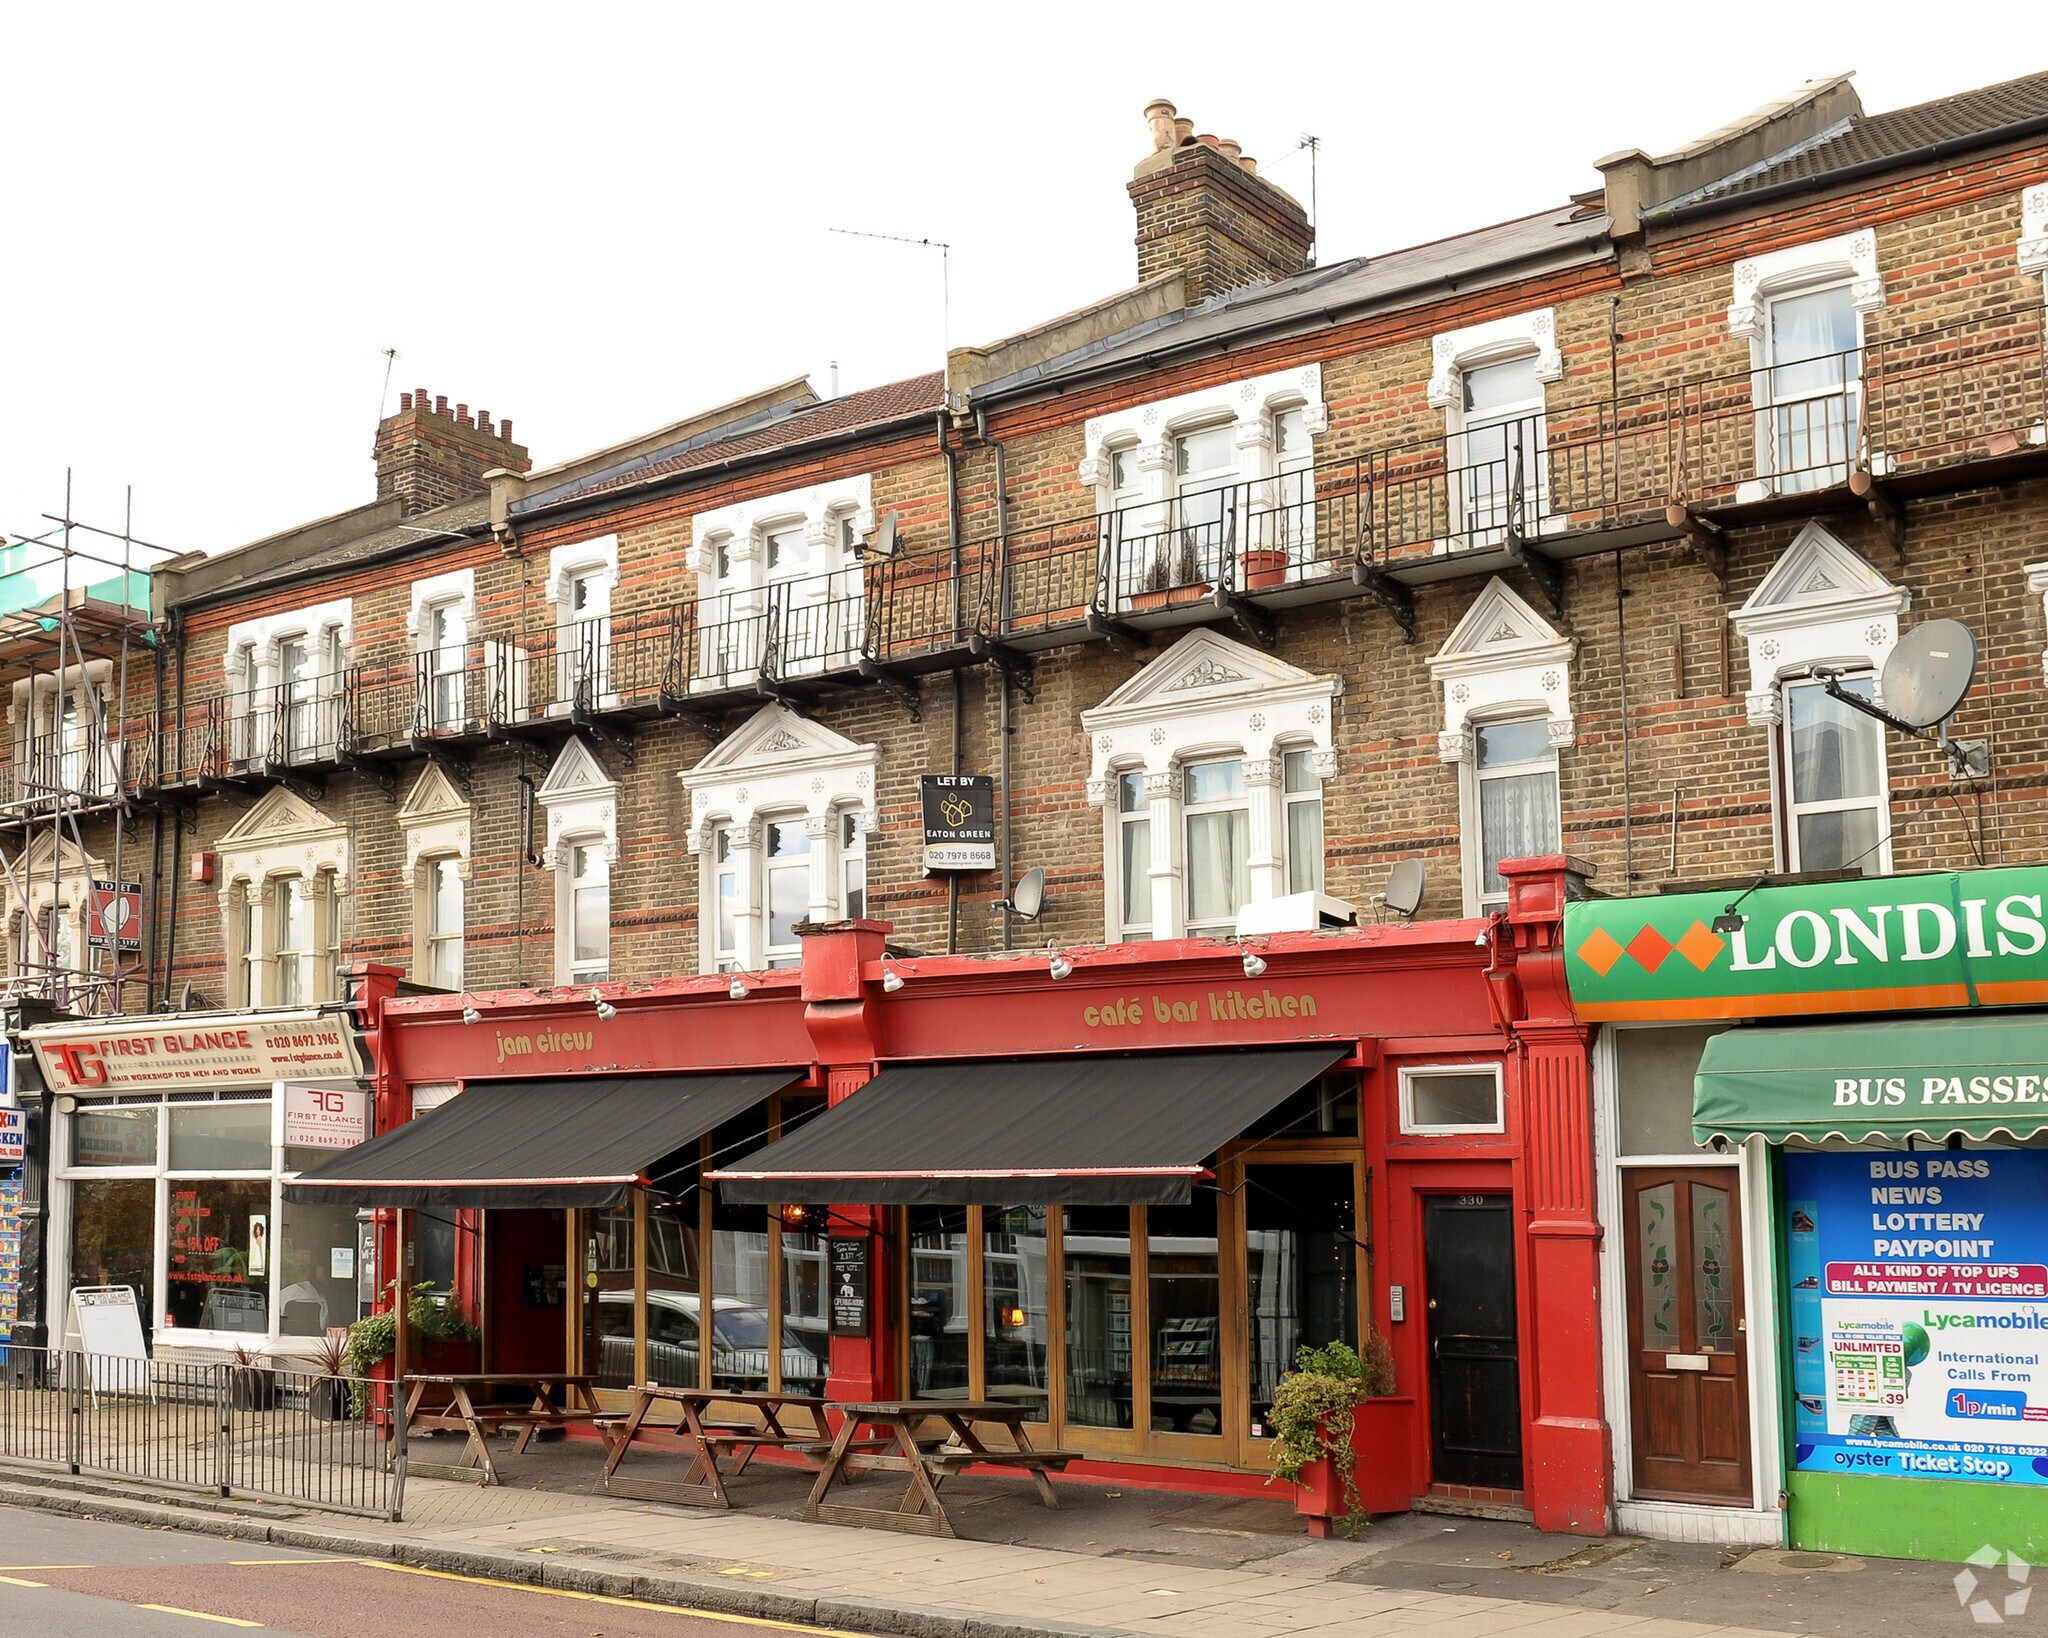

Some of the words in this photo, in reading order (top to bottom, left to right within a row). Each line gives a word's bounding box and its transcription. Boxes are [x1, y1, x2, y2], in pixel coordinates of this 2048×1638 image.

[937, 777, 957, 786] LET
[960, 777, 975, 786] BY
[926, 829, 956, 838] EATON
[959, 830, 991, 838] GREEN
[928, 851, 944, 860] 020
[946, 851, 968, 860] 7978
[969, 851, 991, 860] 8668
[100, 882, 114, 891] TO
[1729, 894, 2048, 971] LONDIS
[1083, 996, 1144, 1027] café
[1152, 995, 1199, 1024] bar
[1208, 989, 1317, 1021] kitchen
[98, 1037, 155, 1057] FIRST
[162, 1030, 252, 1053] GLANCE
[274, 1036, 291, 1049] 020
[292, 1034, 316, 1048] 8692
[316, 1032, 340, 1047] 3965
[495, 1030, 533, 1064] jam
[536, 1026, 594, 1053] circus
[270, 1050, 343, 1064] www.1stglance.co.uk
[111, 1074, 130, 1082] HAIR
[131, 1072, 174, 1081] WORKSHOP
[175, 1070, 191, 1079] FOR
[192, 1069, 210, 1078] MEN
[212, 1068, 229, 1077] AND
[230, 1067, 261, 1075] WOMEN
[1832, 1077, 1906, 1106] BUS
[1919, 1075, 2048, 1105] PASSE
[288, 1112, 317, 1120] FIRST
[321, 1114, 363, 1125] GLANCE
[0, 1132, 23, 1145] KEN
[318, 1136, 338, 1144] 8692
[1870, 1161, 1920, 1179] BUS
[1927, 1160, 1990, 1178] PASS
[1459, 1195, 1484, 1205] 330
[1871, 1187, 1943, 1205] NEWS
[1872, 1213, 1985, 1231] LOTTERY
[204, 1236, 219, 1252] OFF
[1874, 1239, 1995, 1258] PAYPOINT
[1853, 1265, 1881, 1276] ALL
[1885, 1265, 1922, 1277] KIND
[1926, 1265, 1947, 1278] OF
[1951, 1266, 1983, 1278] TOP
[1987, 1267, 2019, 1279] UPS
[1831, 1280, 1864, 1292] BILL
[1867, 1281, 1937, 1293] PAYMENT
[1941, 1282, 1948, 1294] /
[1952, 1282, 1972, 1294] TV
[1977, 1283, 2045, 1296] LICENCE
[1838, 1321, 1894, 1330] Lycamobile
[1834, 1342, 1901, 1353] UNLIMITED
[1938, 1351, 2039, 1365] International
[1947, 1368, 1986, 1380] Calls
[1991, 1370, 2031, 1382] From
[1880, 1393, 1904, 1405] £39
[1953, 1394, 2017, 1416] 1p/min
[1845, 1438, 1962, 1454] www.lycamobile.co.uk
[1963, 1444, 1985, 1453] 020
[1987, 1445, 2016, 1455] 7132
[2018, 1446, 2048, 1456] 0322
[1834, 1451, 1893, 1469] oyster
[1897, 1452, 1961, 1474] Ticket
[1963, 1455, 2012, 1480] Stop
